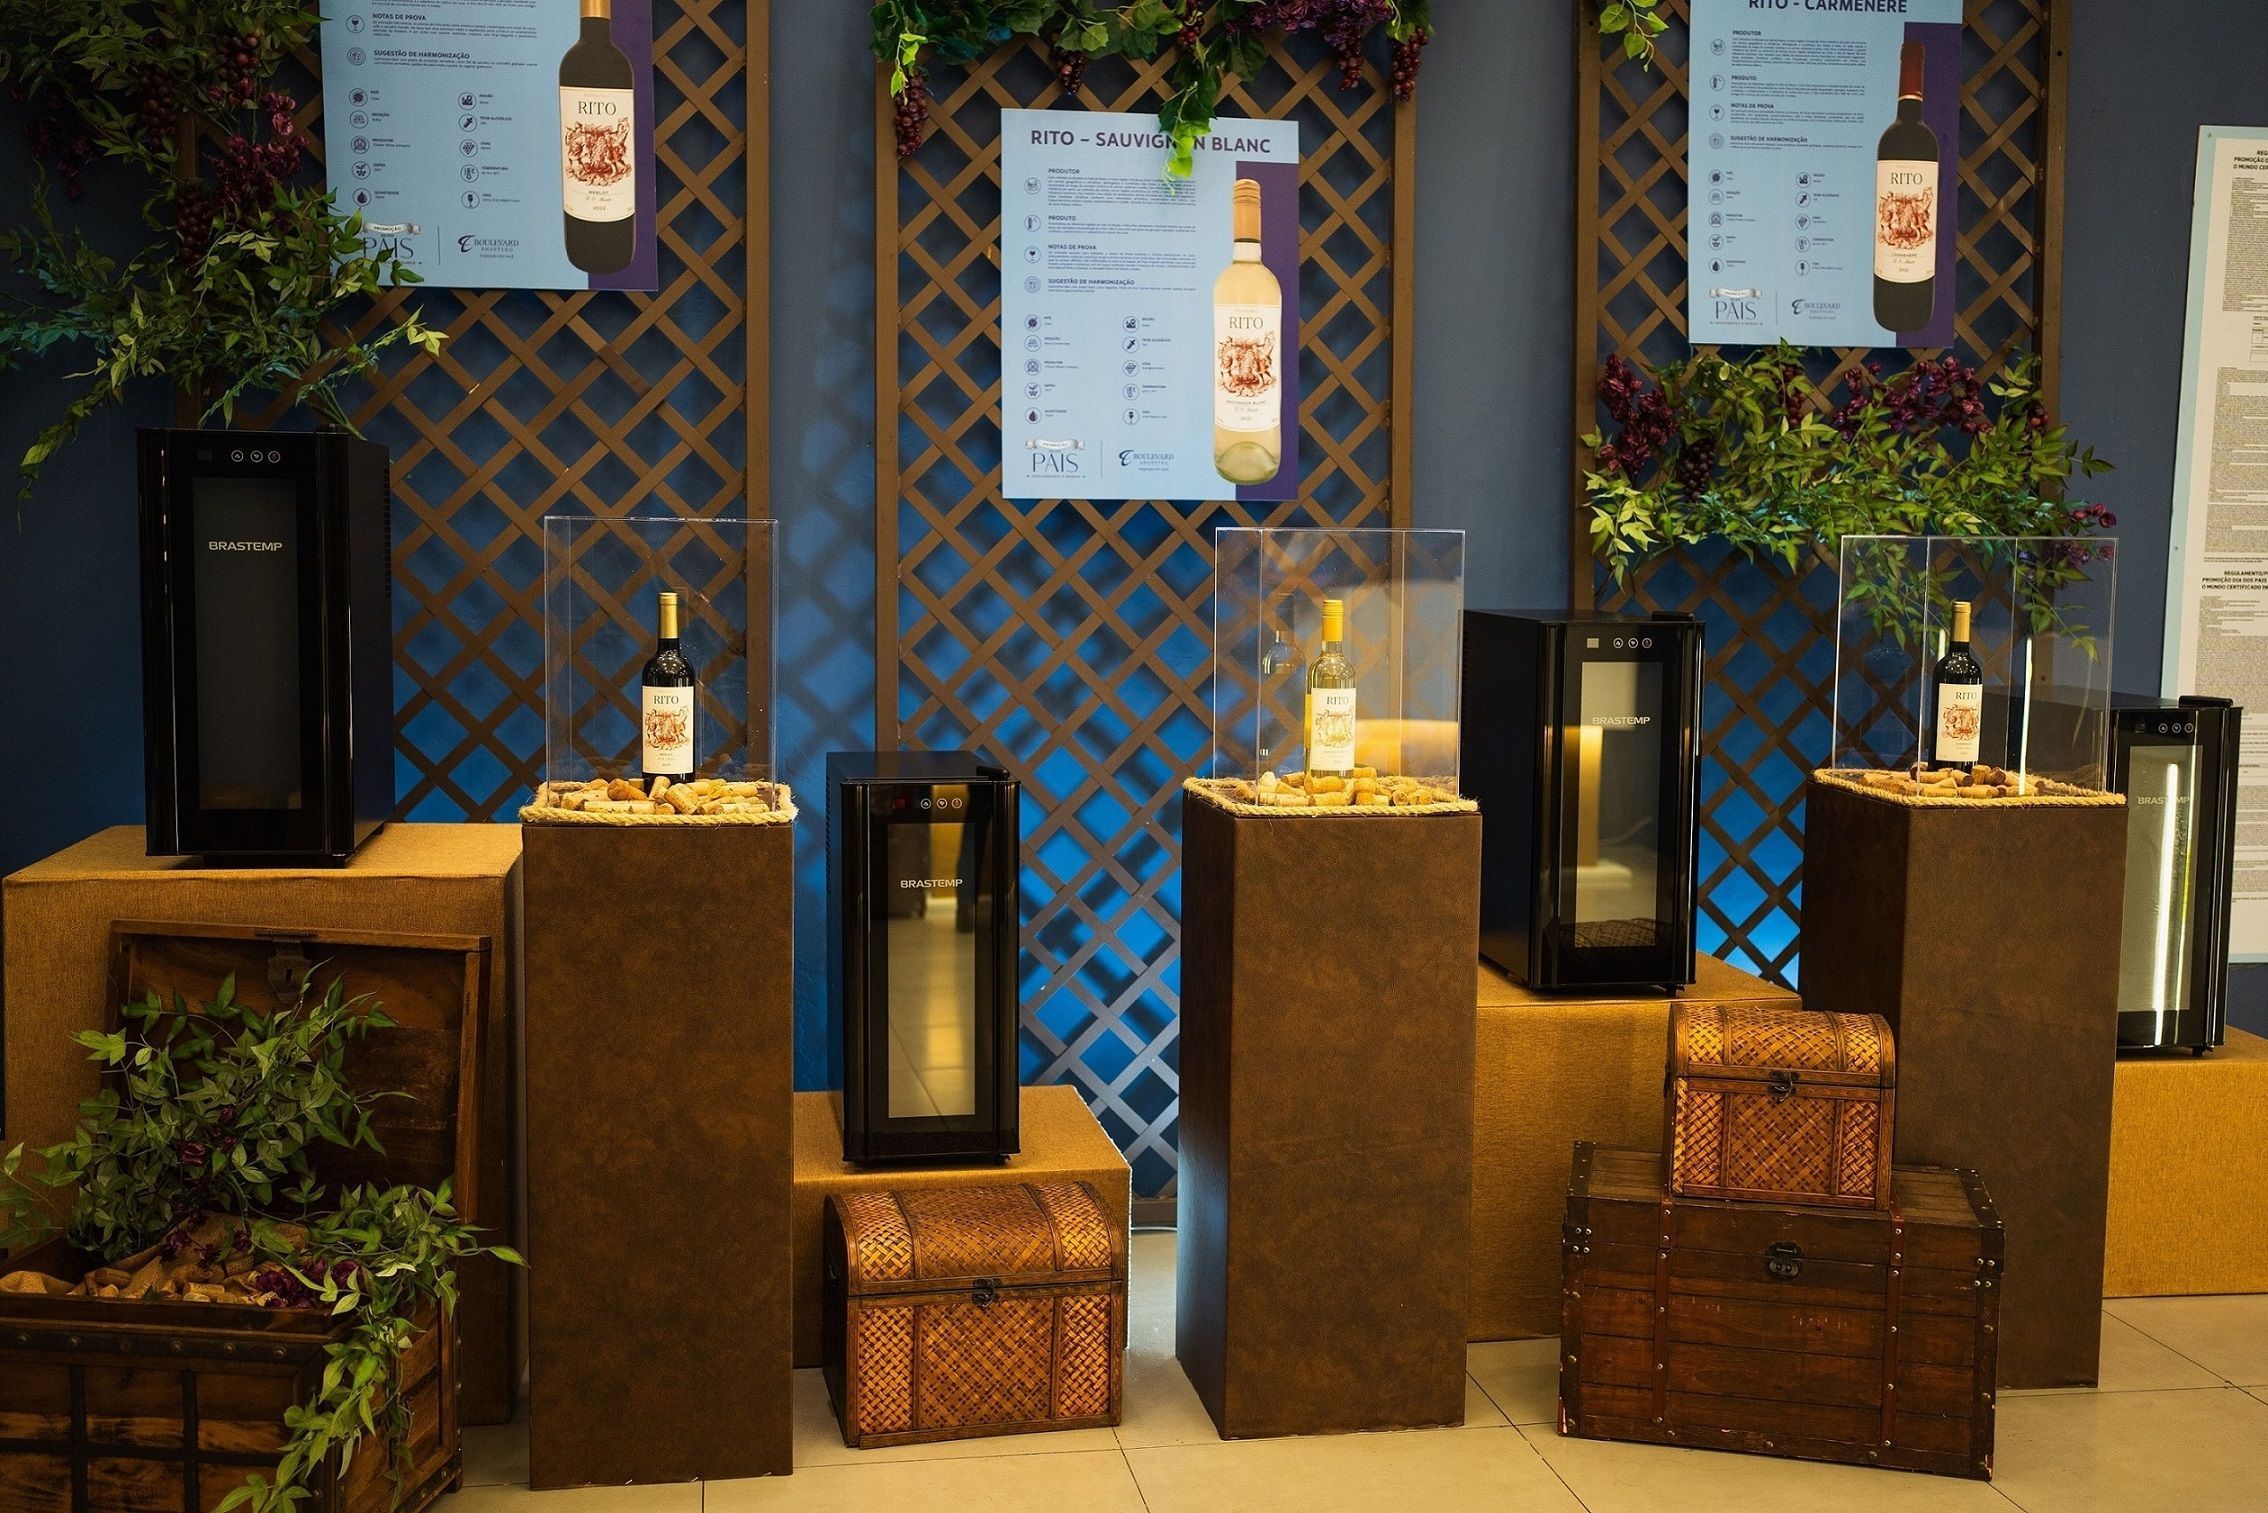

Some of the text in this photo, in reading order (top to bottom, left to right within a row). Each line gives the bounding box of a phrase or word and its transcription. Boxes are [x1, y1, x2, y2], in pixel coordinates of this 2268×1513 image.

[1749, 0, 1788, 9] RITO
[1805, 0, 1908, 13] CARMENERE
[374, 49, 408, 57] SUGESTÃO
[418, 51, 470, 60] HARMONIZAÇÃO
[578, 101, 616, 115] RITO
[1030, 130, 1074, 146] RITO
[1096, 132, 1206, 150] SAUVIGNN
[1212, 137, 1271, 154] BLANC
[1766, 136, 1808, 144] HARMONIZAÇÃO
[1890, 172, 1923, 185] RITO
[363, 236, 414, 259] PAIS
[474, 239, 520, 248] BOULEVARD
[1088, 278, 1135, 286] HARMONIZAÇÃO
[1715, 300, 1757, 320] PAIS
[1229, 316, 1264, 329] RITO
[1032, 452, 1079, 473] PAIS
[208, 541, 283, 551] BRASTEMP
[653, 696, 679, 704] RITO
[1326, 696, 1350, 705] RITO
[1955, 692, 1977, 700] RITO
[1592, 716, 1651, 725] BRASTEMP
[900, 879, 963, 888] BRASTEMP
